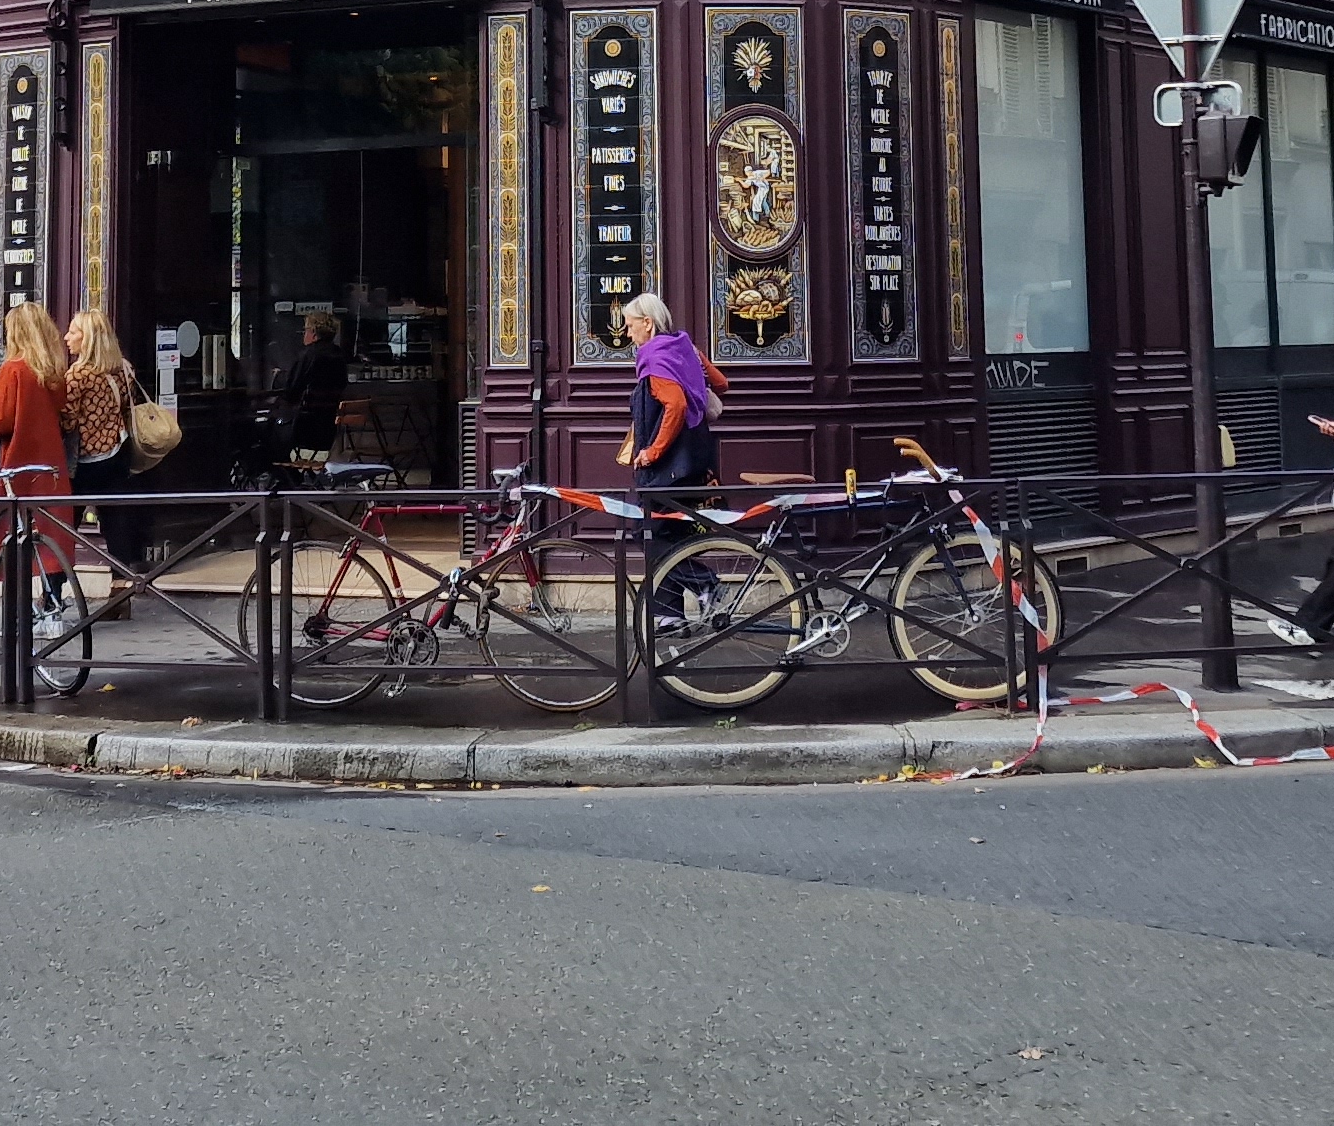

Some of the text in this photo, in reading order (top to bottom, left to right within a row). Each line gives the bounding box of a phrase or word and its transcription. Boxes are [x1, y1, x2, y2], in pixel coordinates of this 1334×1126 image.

[589, 69, 637, 90] SANDWICHES
[591, 146, 636, 165] PATISSERIES
[598, 225, 632, 242] TRAITEUR
[600, 276, 632, 294] SALADES
[869, 275, 899, 290] SUR PLACE
